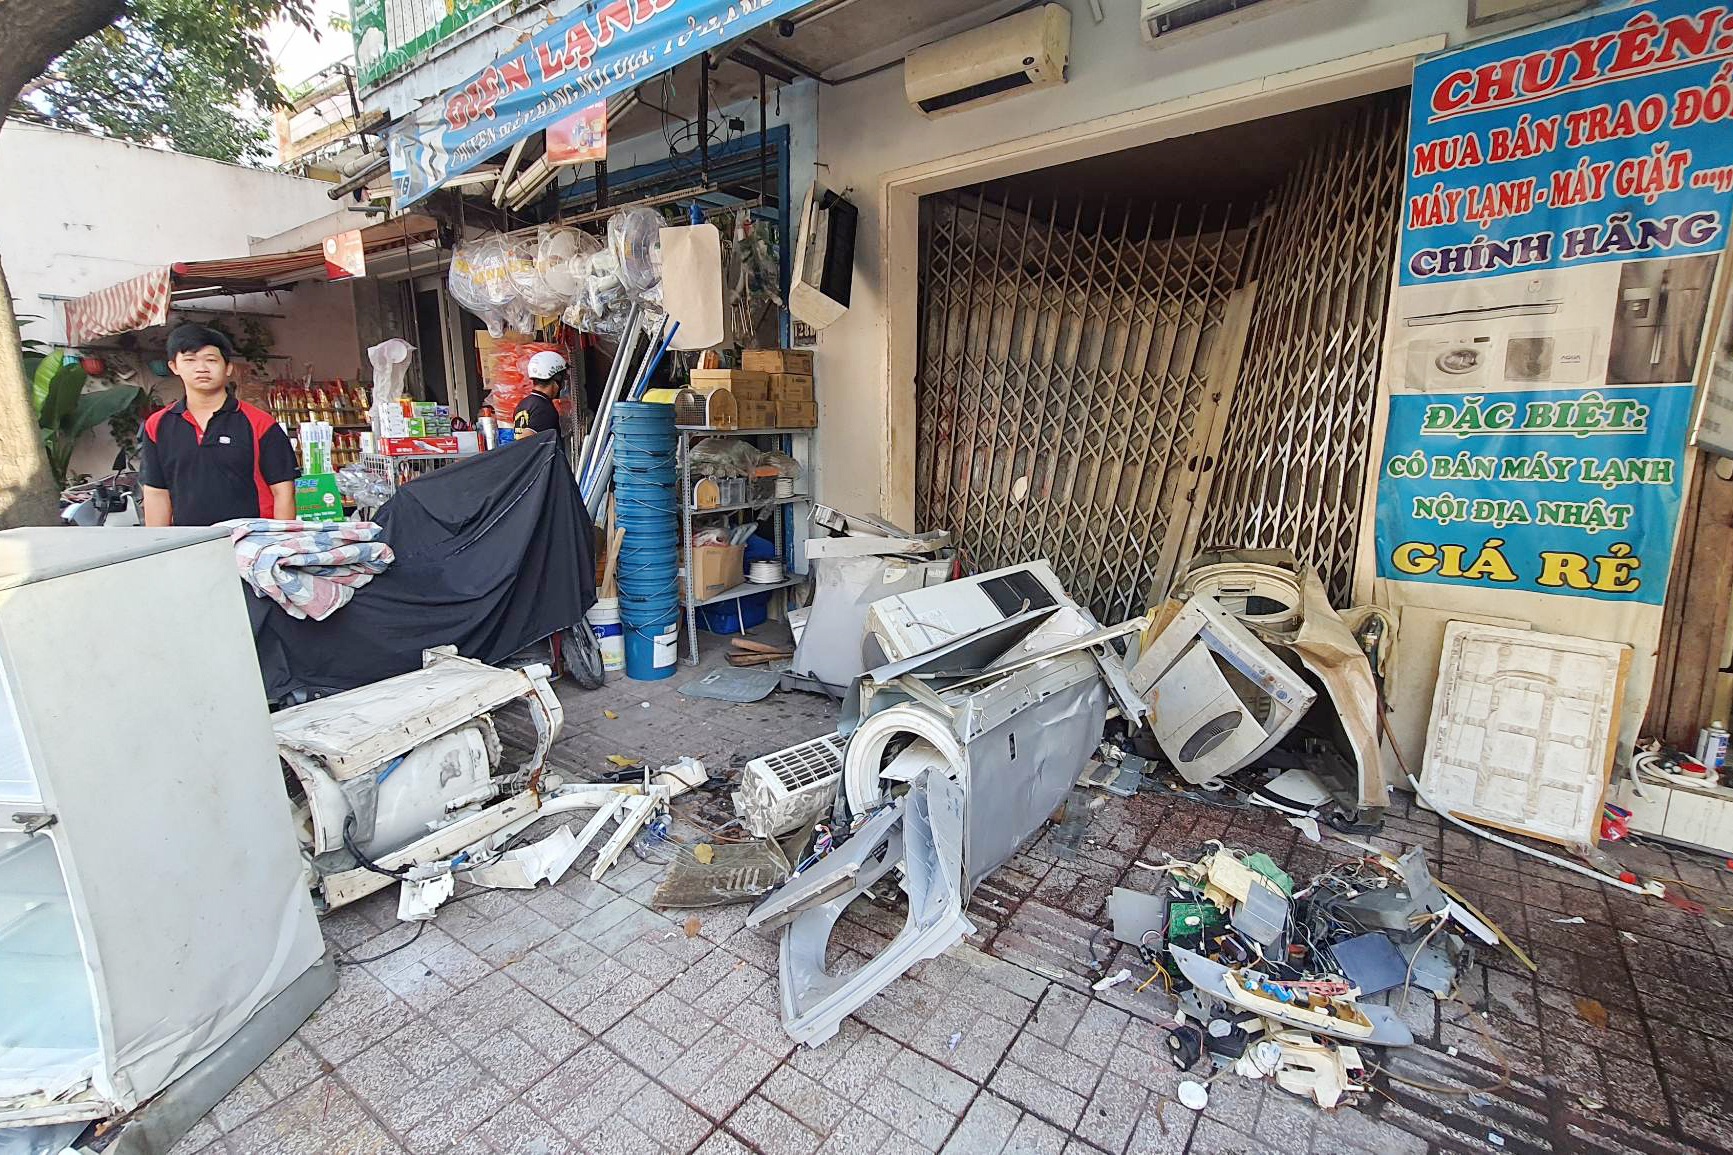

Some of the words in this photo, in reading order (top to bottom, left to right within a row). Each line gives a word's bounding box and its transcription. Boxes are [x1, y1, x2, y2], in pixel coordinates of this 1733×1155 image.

[1414, 135, 1480, 176] MUA
[1489, 115, 1559, 162] BÁN
[1567, 96, 1665, 147] TRAO
[1674, 62, 1733, 127] ĐỔ
[1410, 184, 1462, 228] MÁY
[1615, 142, 1689, 204] GIẶT
[1410, 234, 1552, 276] CHÍNH
[1563, 214, 1718, 259] HÃNG
[1423, 397, 1514, 437] ĐẶC
[1523, 393, 1649, 437] BIỆT:
[1388, 451, 1425, 478] CÓ
[1433, 452, 1495, 479] BÁN
[1502, 452, 1577, 480] MÁY
[1580, 457, 1674, 488] LẠNH
[1415, 493, 1465, 523] NỘI
[1474, 499, 1529, 527] ĐỊA
[1538, 498, 1633, 532] NHẬT
[1392, 538, 1518, 581] GIÁ
[1536, 543, 1641, 591] RẺ
